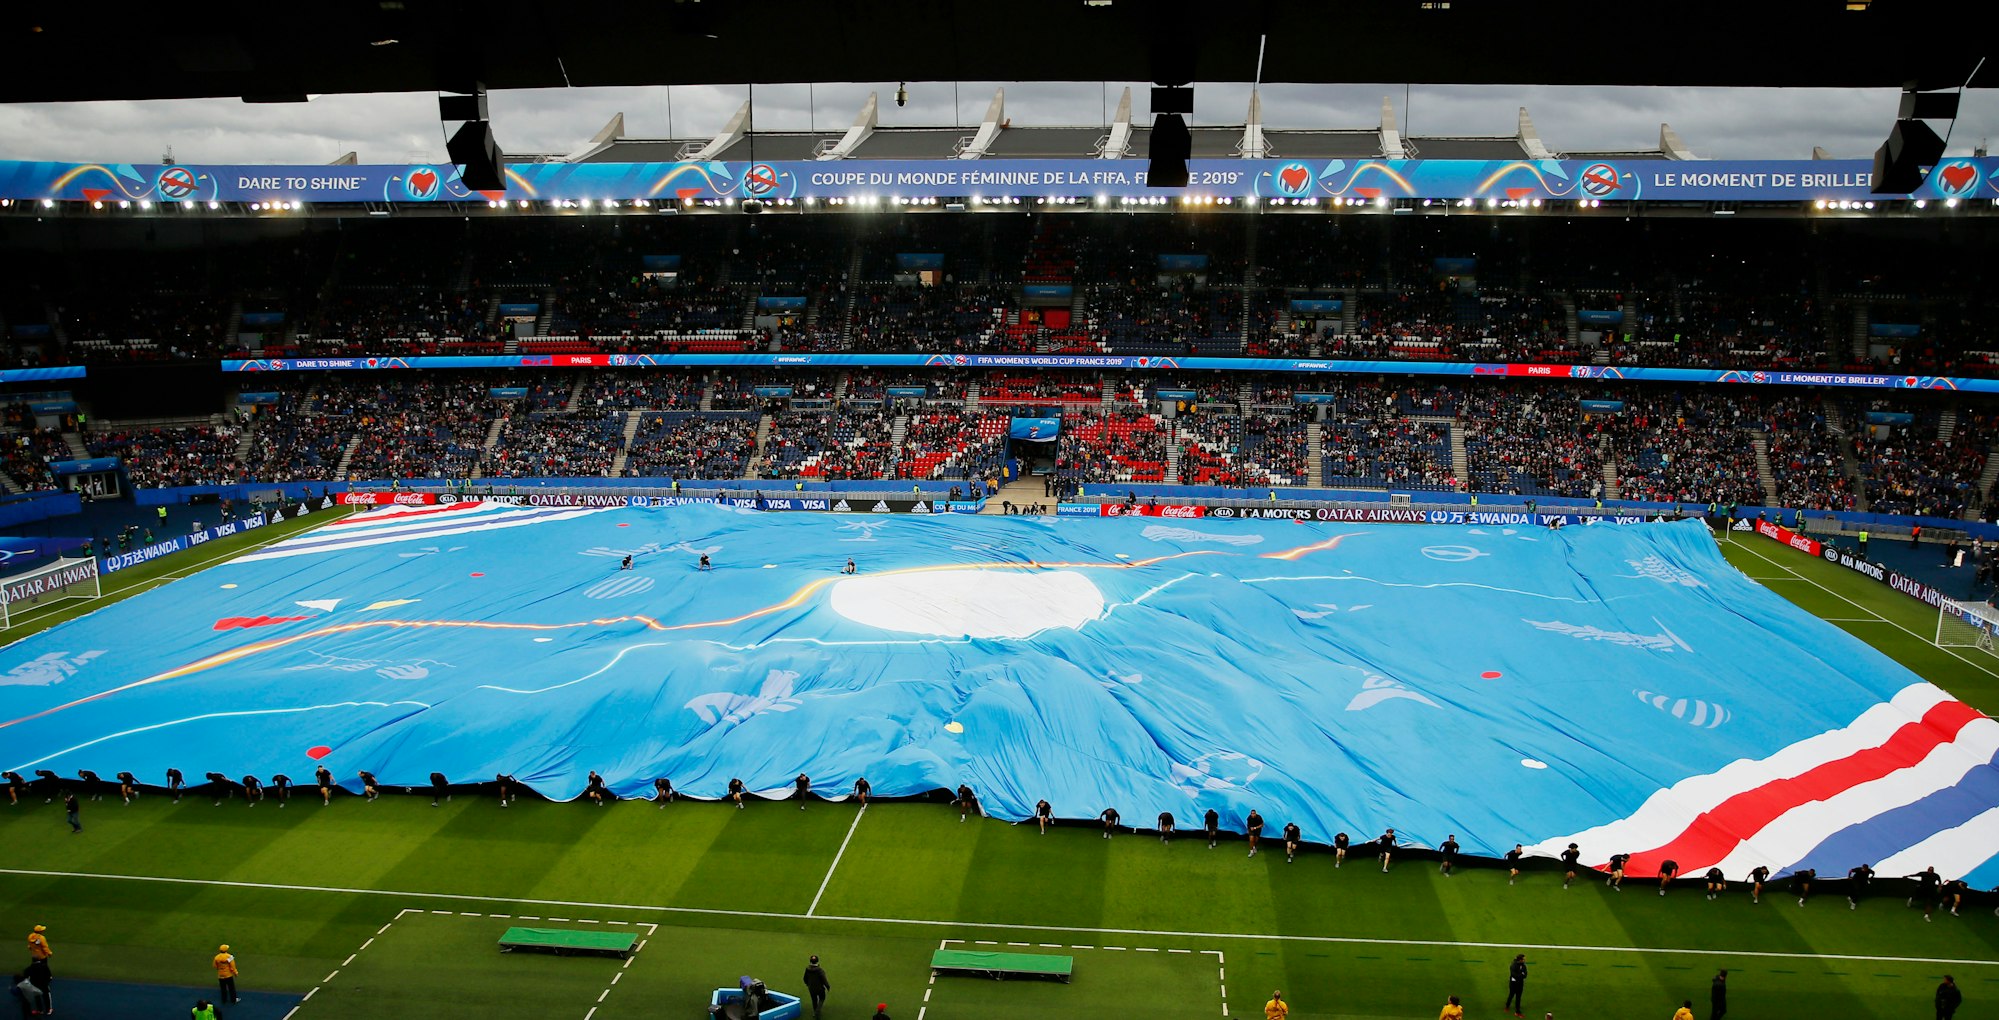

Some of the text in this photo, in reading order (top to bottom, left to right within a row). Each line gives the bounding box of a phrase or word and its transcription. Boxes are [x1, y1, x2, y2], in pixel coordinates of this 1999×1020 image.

[238, 177, 281, 190] DARE
[285, 177, 307, 190] TO
[811, 172, 866, 185] COUPE
[870, 172, 892, 185] DU
[897, 172, 957, 186] MONDE
[961, 170, 1039, 187] FÉMININE
[1043, 172, 1065, 184] DE
[1069, 172, 1089, 184] LA
[1093, 172, 1131, 186] FIFA,
[1654, 173, 1676, 187] LE
[1681, 173, 1767, 188] MOMENT
[1772, 173, 1796, 187] DE
[296, 360, 317, 368] DARE
[317, 360, 328, 368] TO
[571, 356, 592, 364] PARIS
[993, 357, 1030, 365] WOMEN'S
[1031, 357, 1058, 365] WORLD
[1059, 357, 1075, 365] CUP
[1528, 366, 1551, 374] PARIS
[1780, 374, 1791, 383] LE
[1793, 374, 1833, 384] MOMENT
[1834, 375, 1846, 384] DE
[462, 495, 479, 503] KIA
[529, 494, 571, 506] QATAR
[732, 498, 757, 509] VISA
[766, 499, 791, 509] VISA
[800, 499, 826, 510] VISA
[1240, 508, 1260, 518] KA
[1316, 508, 1426, 521] QATAR AIRWAYS
[242, 515, 264, 530] VISA
[1614, 516, 1640, 525] VISA
[214, 522, 237, 538] VISA
[189, 531, 210, 545] VISA
[1840, 554, 1884, 581] KIA MOTORS
[1890, 573, 1920, 598] QATAR
[0, 579, 44, 605] QATAR
